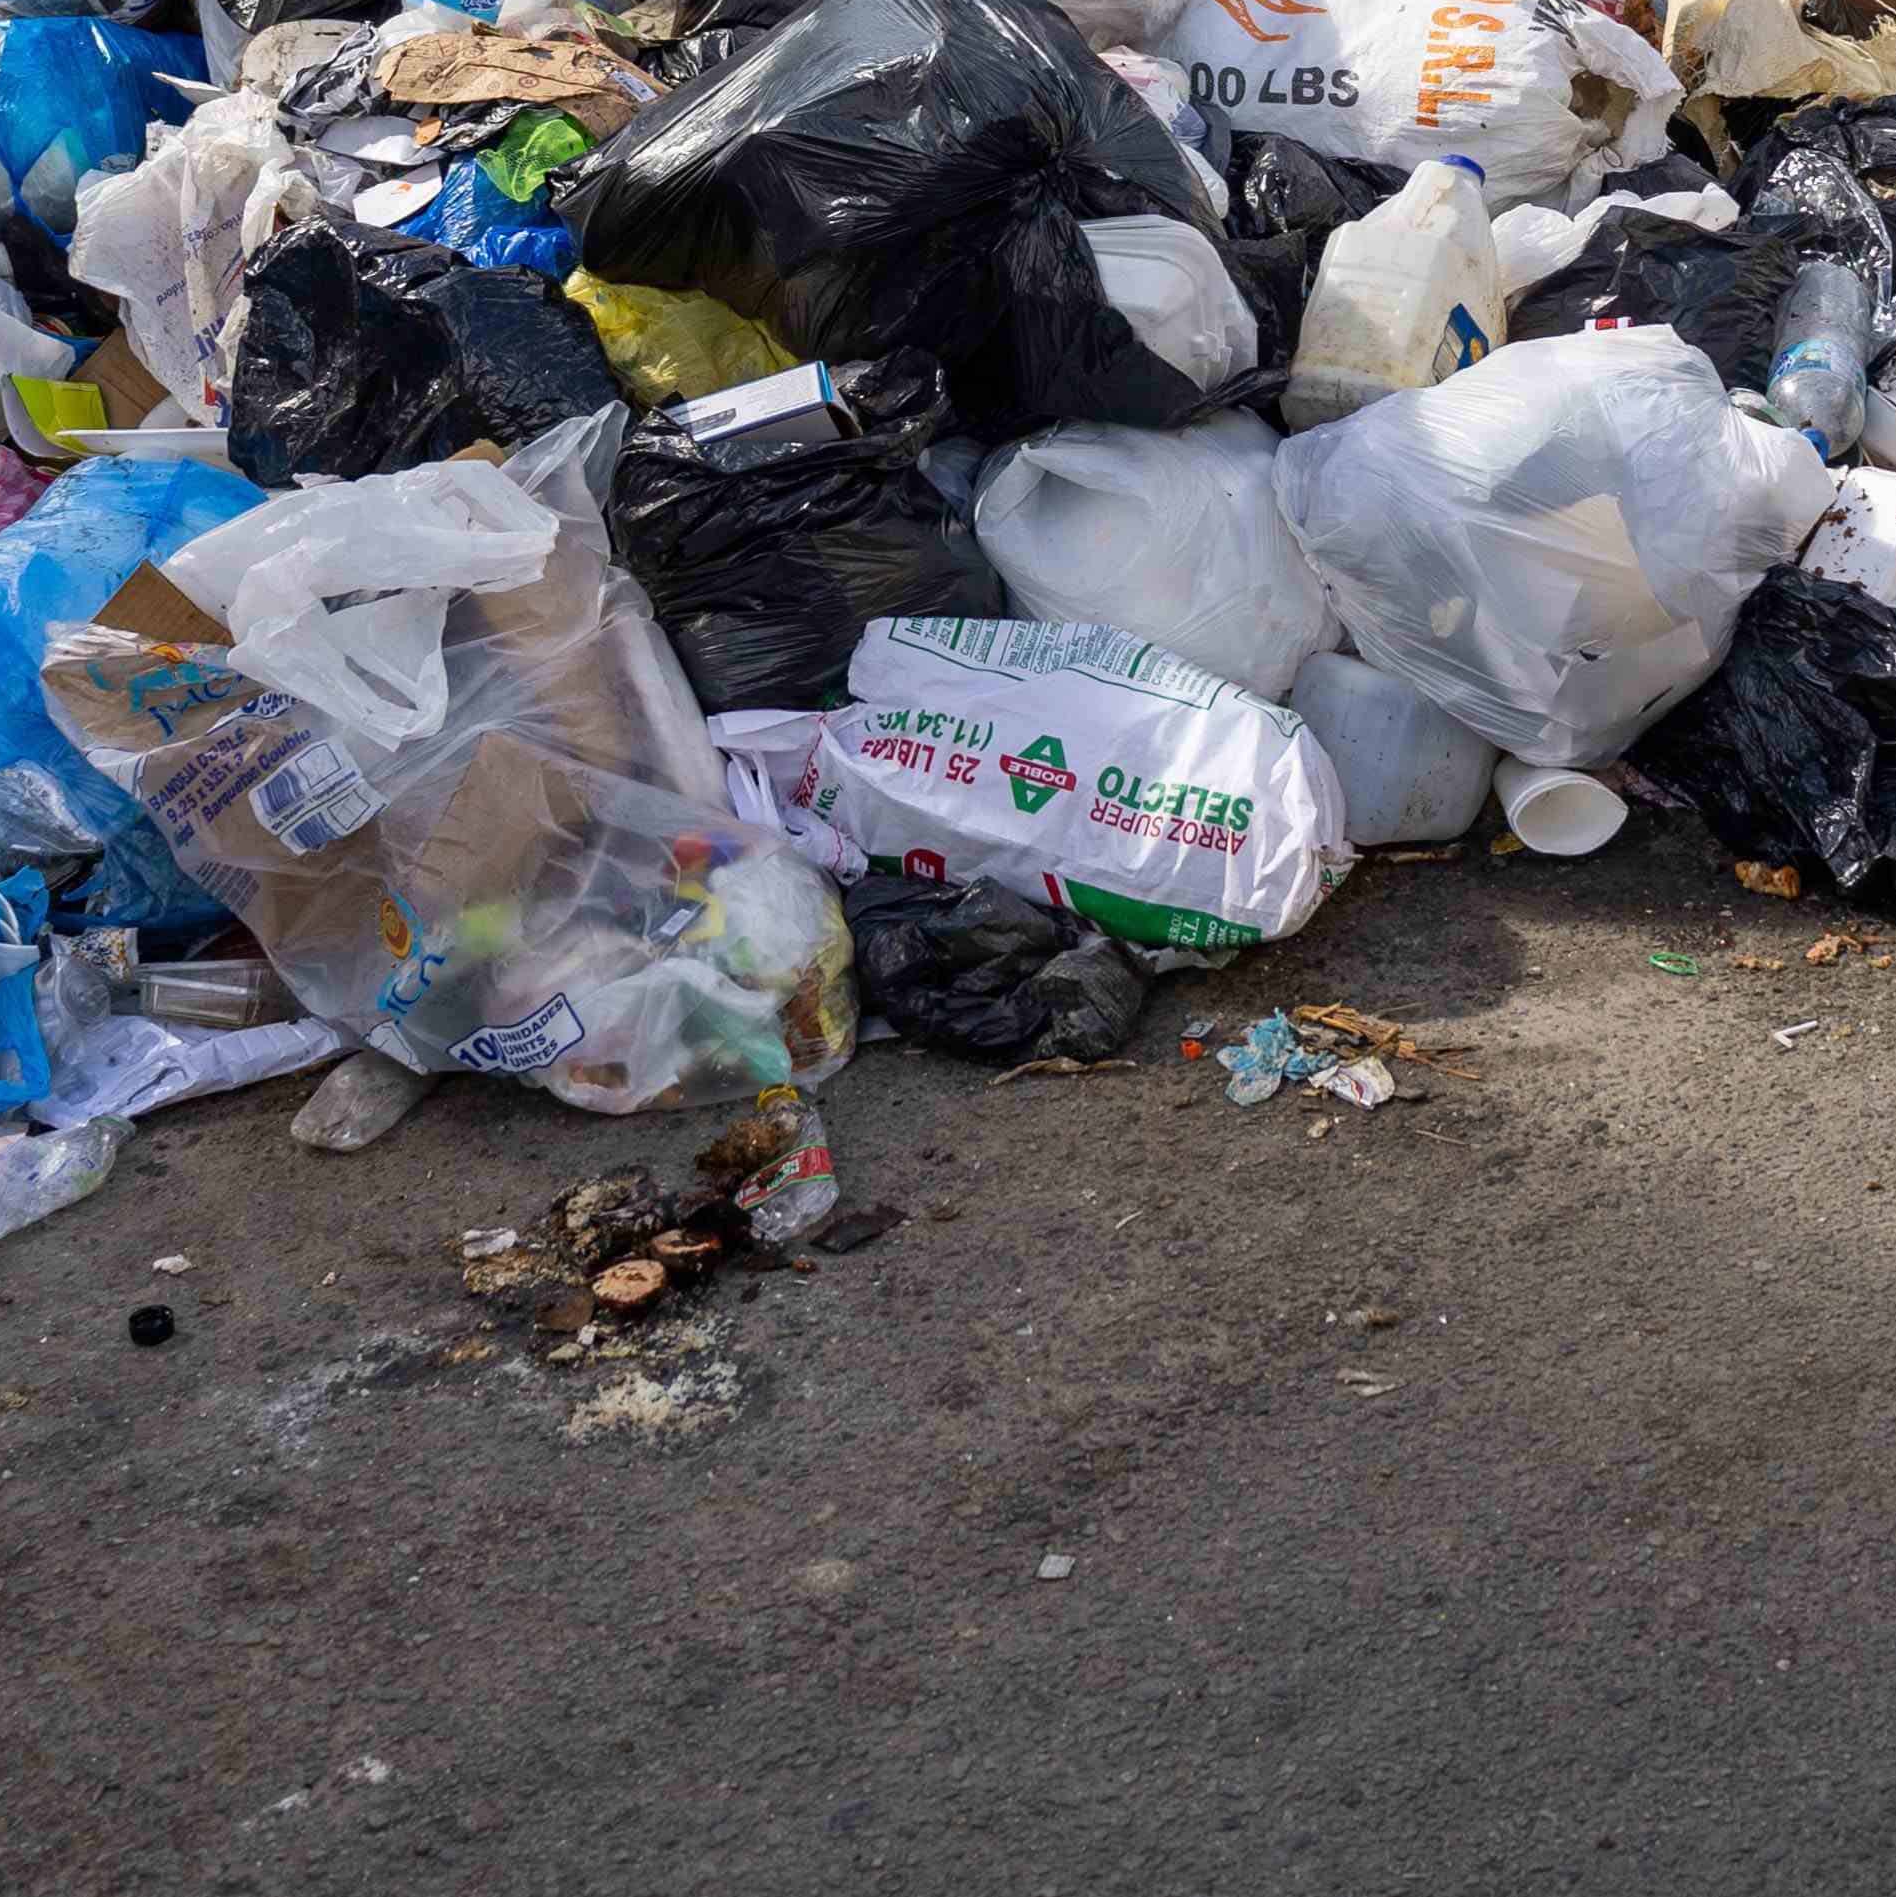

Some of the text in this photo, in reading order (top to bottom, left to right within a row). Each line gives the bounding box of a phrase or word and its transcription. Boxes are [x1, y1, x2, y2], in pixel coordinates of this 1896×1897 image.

[1257, 67, 1360, 108] LBS
[917, 709, 994, 752] (11.34
[944, 752, 982, 785] 25
[1007, 760, 1068, 788] DOBLE
[167, 792, 197, 824] 9.25
[1097, 765, 1254, 832] SELECTO
[1090, 796, 1247, 856] ARROZ SUPER
[498, 999, 564, 1043] UNIDADES
[503, 1033, 547, 1057] UNITS
[510, 1039, 559, 1069] UNITES
